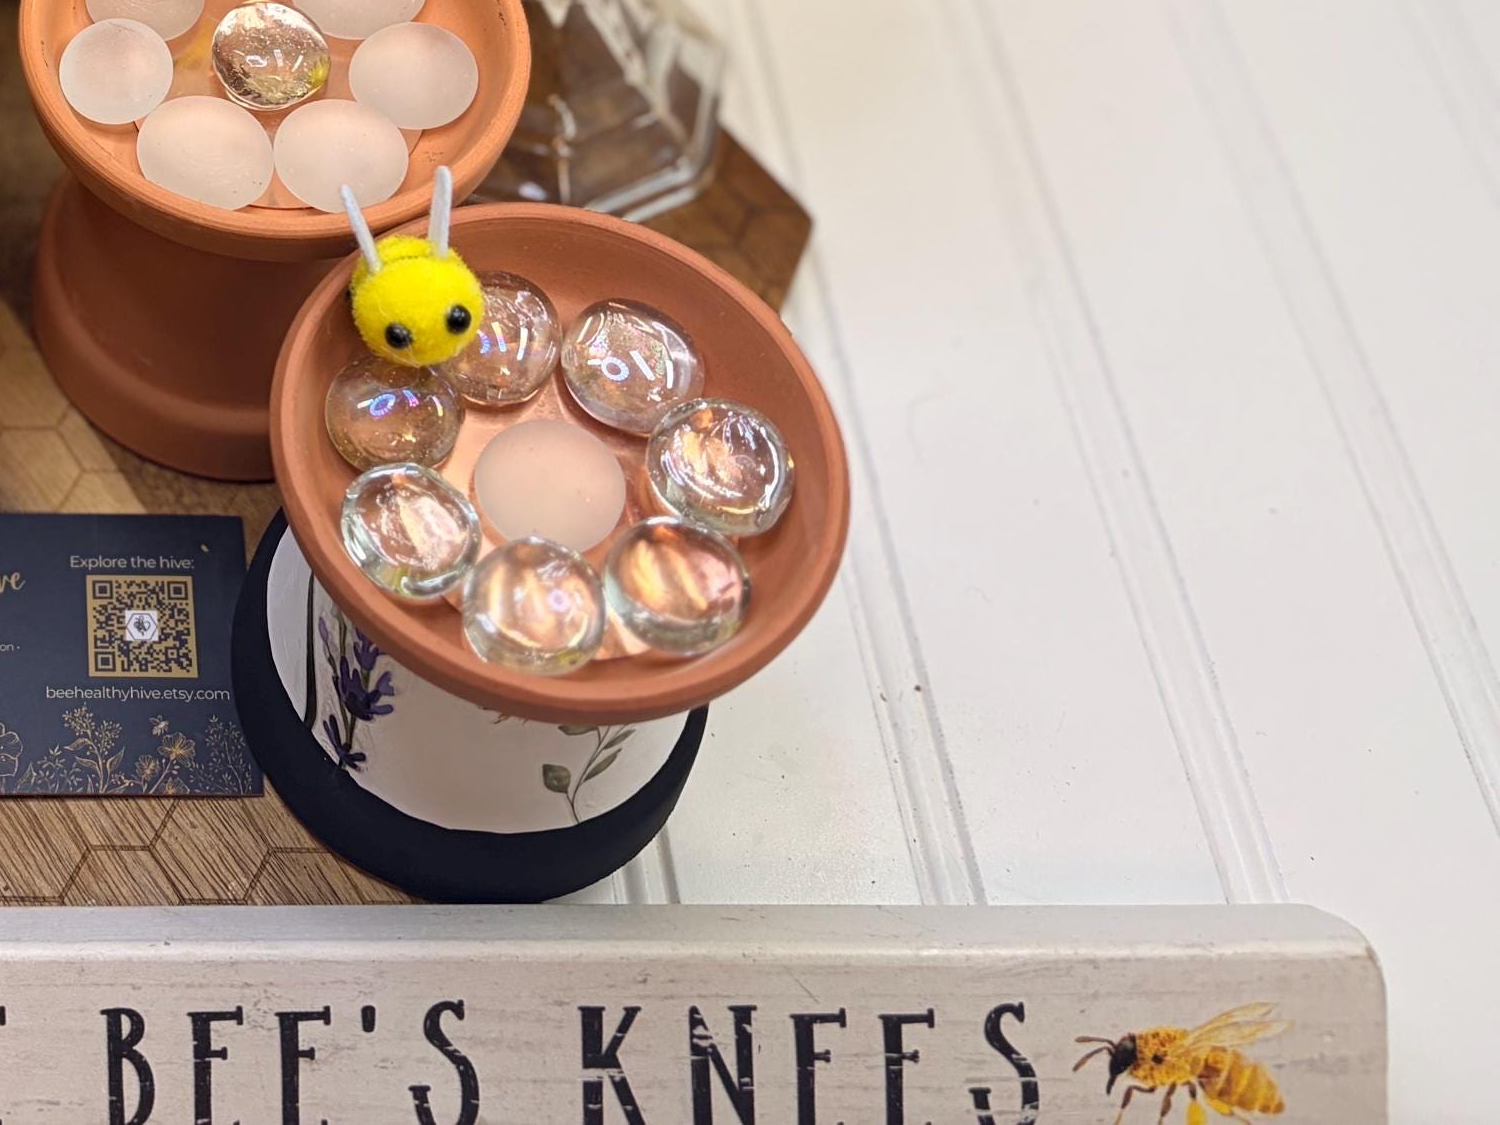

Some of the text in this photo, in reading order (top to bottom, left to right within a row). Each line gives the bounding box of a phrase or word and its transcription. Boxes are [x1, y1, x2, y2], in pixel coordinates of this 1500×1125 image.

[69, 556, 195, 570] Explore the hive:
[45, 686, 231, 702] beehealthyhive.etsy.com
[99, 999, 482, 1125] BEE'S
[576, 1001, 1041, 1125] KNEES
